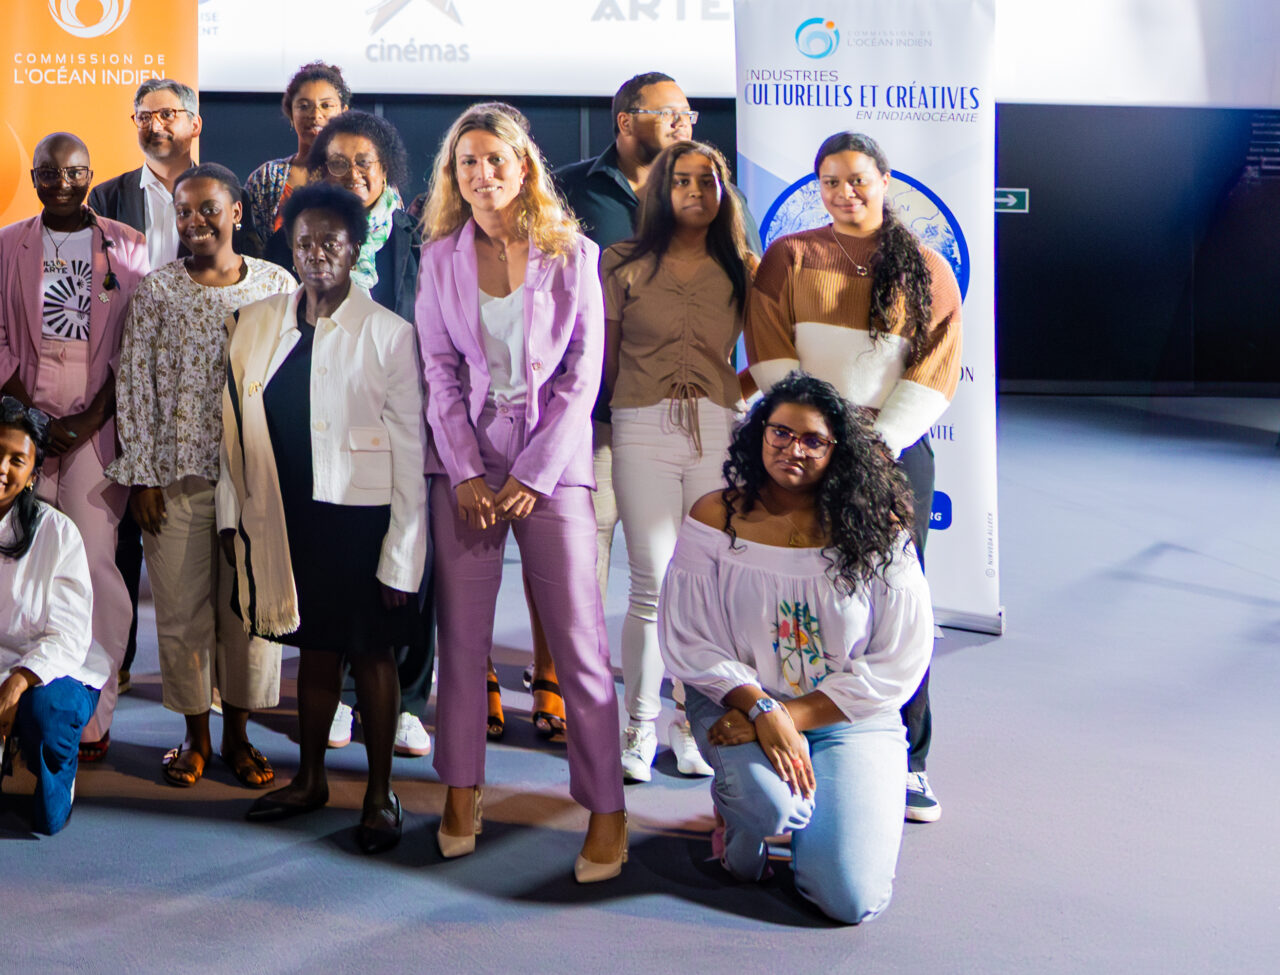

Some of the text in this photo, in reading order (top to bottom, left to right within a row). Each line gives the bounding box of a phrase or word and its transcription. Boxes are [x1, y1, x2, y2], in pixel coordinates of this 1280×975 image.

[896, 38, 933, 48] INDIEN
[365, 38, 471, 63] cinémas
[14, 53, 165, 65] COMMISSION DE
[14, 66, 96, 85] L'OCÉAN
[746, 69, 839, 82] INDUSTRIES
[744, 80, 980, 110] CULTURELLES ET CRÉATIVES
[856, 110, 978, 123] EN INDIANOCÉANIE
